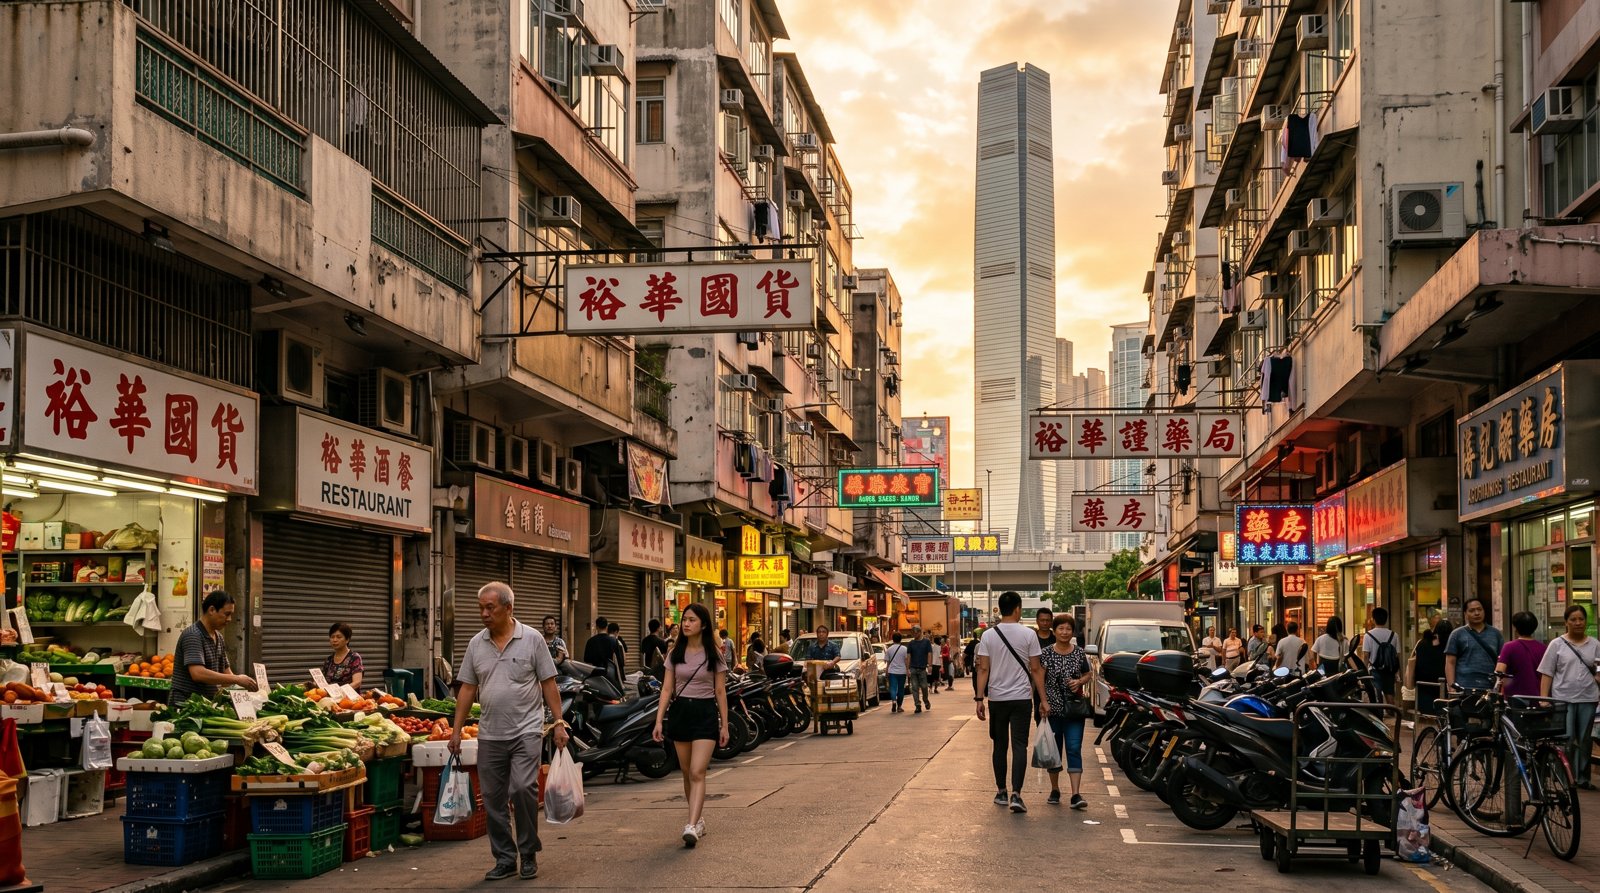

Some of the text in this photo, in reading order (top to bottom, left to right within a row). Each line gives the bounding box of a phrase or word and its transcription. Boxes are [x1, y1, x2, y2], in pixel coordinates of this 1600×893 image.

[579, 269, 799, 322] 裕華國貨
[45, 358, 245, 475] 裕華國貨
[1035, 418, 1234, 454] 裕華謹藥局
[321, 432, 413, 491] 裕華酒餐
[1508, 460, 1552, 491] RESTAURANT
[321, 481, 412, 518] RESTAURANT
[1080, 498, 1146, 529] 藥房
[1244, 510, 1307, 543] 藥房
